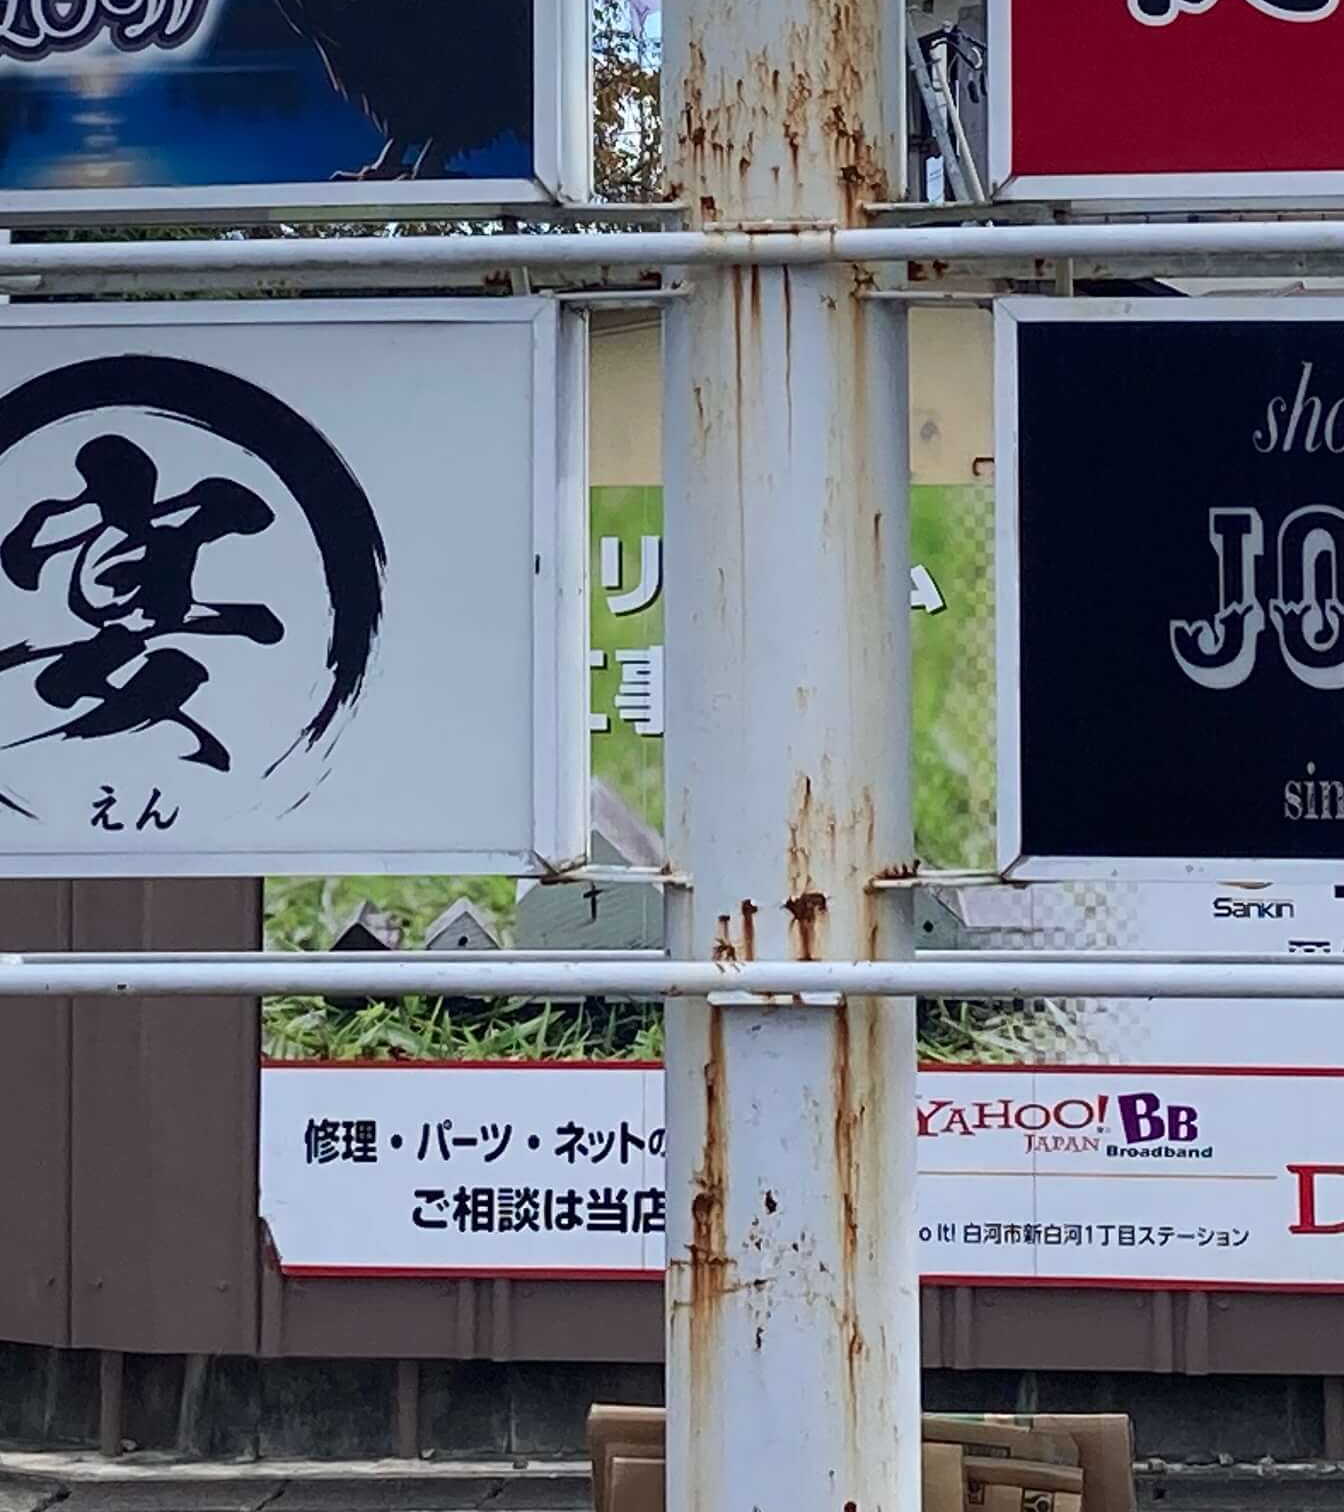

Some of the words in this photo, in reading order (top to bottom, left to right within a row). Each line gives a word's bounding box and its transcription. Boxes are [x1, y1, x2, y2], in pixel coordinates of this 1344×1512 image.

[89, 785, 180, 833] えん
[1213, 898, 1294, 919] Sankin
[1024, 1134, 1100, 1154] JAPAN
[1106, 1144, 1213, 1159] Broadband
